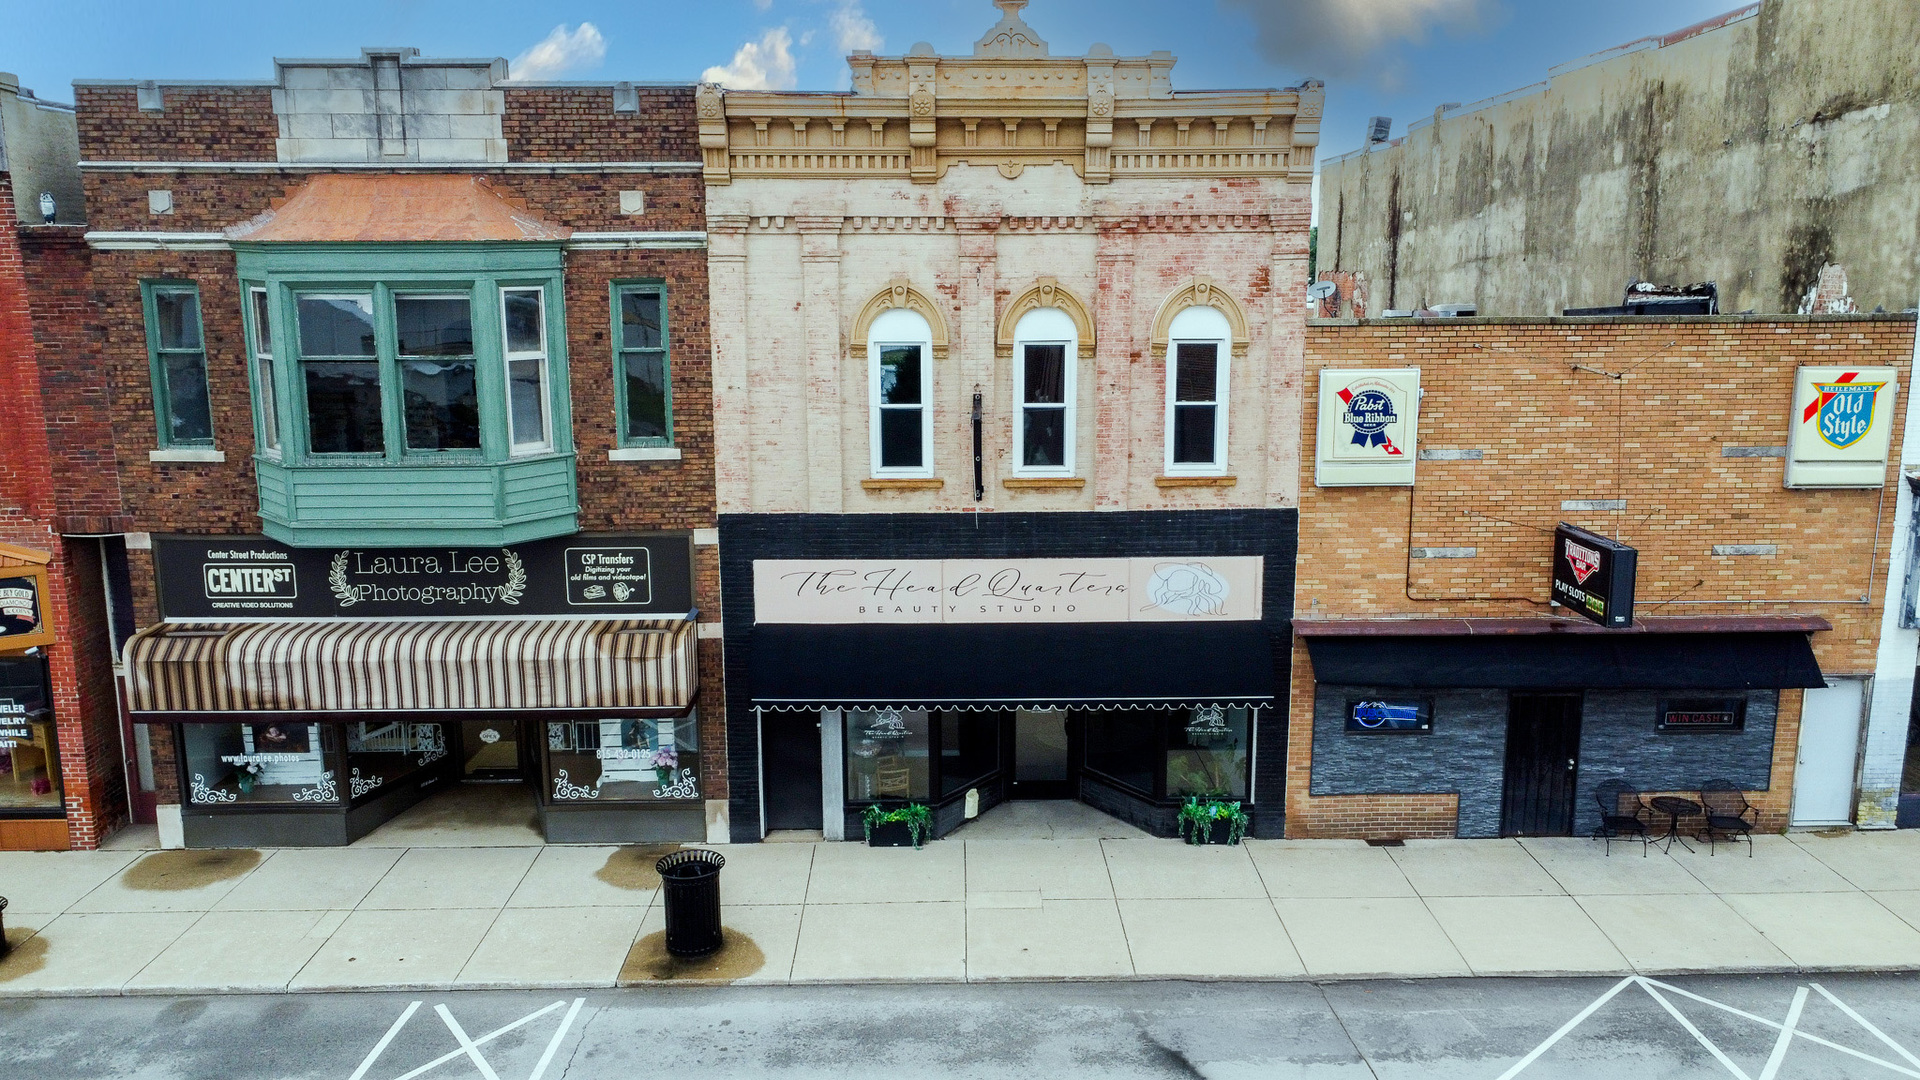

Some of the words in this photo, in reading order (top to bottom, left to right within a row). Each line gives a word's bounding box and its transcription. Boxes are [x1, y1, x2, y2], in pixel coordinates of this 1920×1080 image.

[1355, 396, 1386, 411] Pabst
[1833, 394, 1864, 415] Old
[1344, 413, 1364, 423] Blue
[1365, 412, 1396, 423] Ribbon
[1823, 412, 1866, 443] Style
[207, 550, 229, 559] Center
[229, 550, 249, 559] Street
[250, 550, 288, 560] Productions
[581, 554, 596, 565] CSP
[597, 553, 634, 564] Transfers
[1565, 539, 1600, 572] TRADITIONS
[354, 552, 443, 575] Laura
[448, 551, 500, 573] Lee
[1576, 559, 1587, 571] BAR
[585, 566, 615, 574] Digitizing
[780, 569, 857, 597] The
[861, 567, 982, 601] Head
[981, 567, 1129, 602] Quarters
[1555, 579, 1569, 593] PLAY
[1568, 585, 1586, 602] SLOTS
[356, 583, 501, 604] Photography
[858, 605, 957, 614] BEAUTY
[979, 605, 1077, 613] STUDIO
[0, 717, 26, 725] ELRY
[1668, 714, 1689, 722] WIN
[1692, 714, 1719, 722] CASH
[221, 752, 300, 764] www.lauralee.photos
